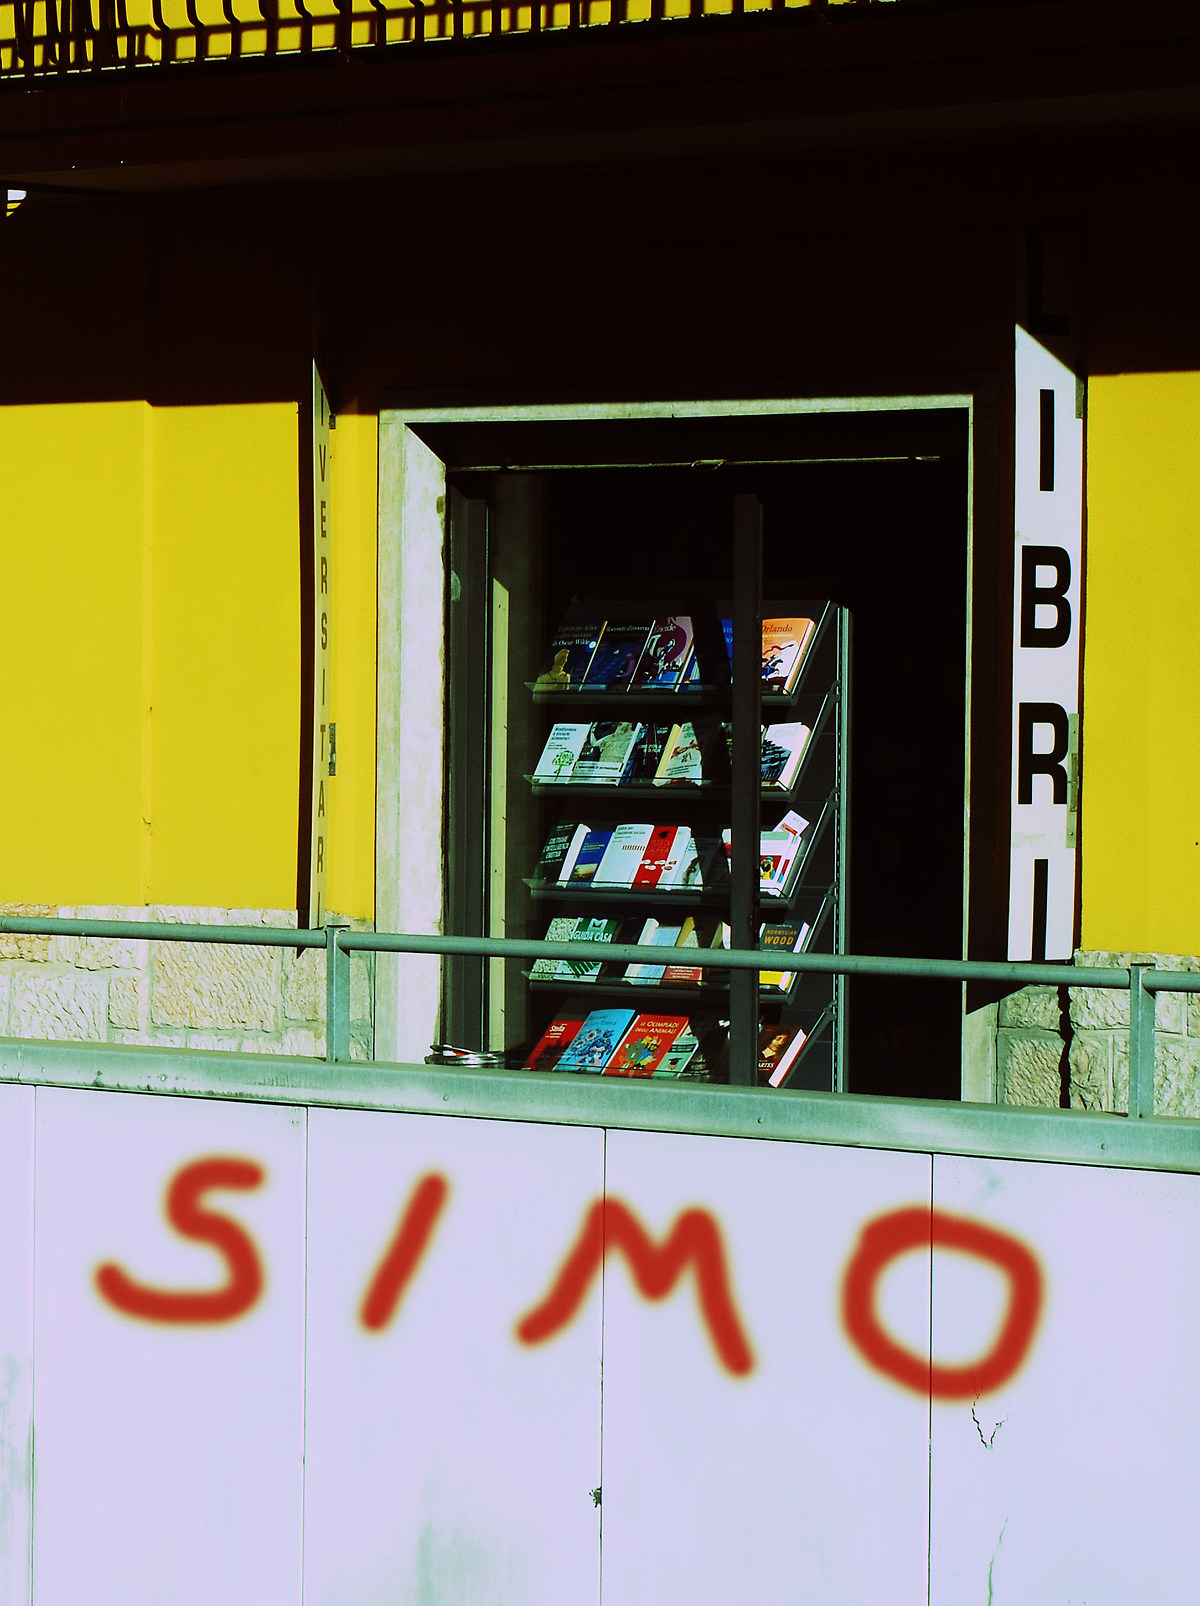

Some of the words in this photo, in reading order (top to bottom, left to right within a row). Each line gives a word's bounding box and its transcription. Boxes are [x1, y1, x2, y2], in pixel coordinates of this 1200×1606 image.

[573, 930, 593, 941] GUIDA
[593, 932, 613, 943] CASA
[764, 936, 794, 945] WOOD
[96, 1158, 1043, 1402] SIMO
